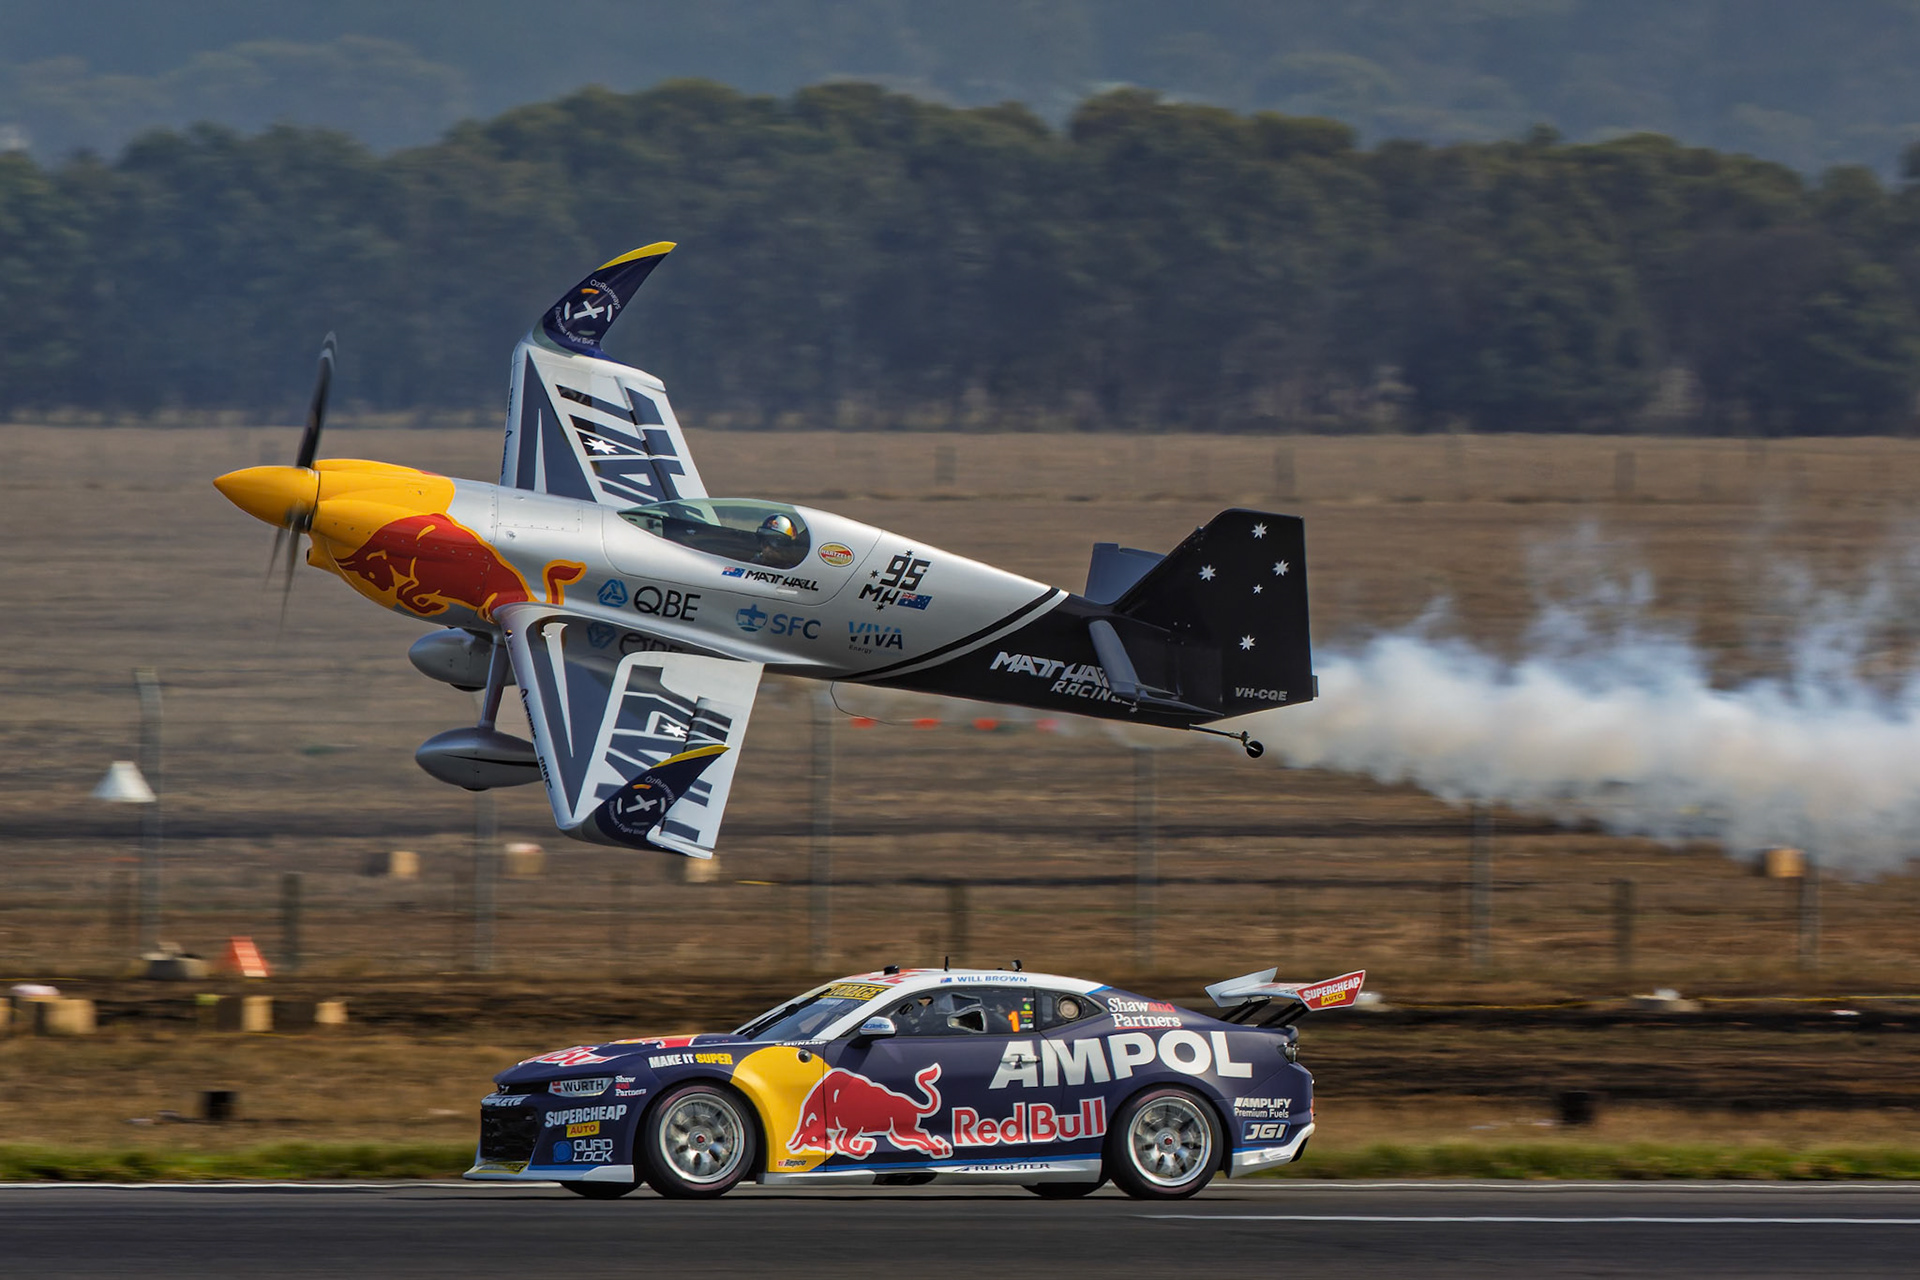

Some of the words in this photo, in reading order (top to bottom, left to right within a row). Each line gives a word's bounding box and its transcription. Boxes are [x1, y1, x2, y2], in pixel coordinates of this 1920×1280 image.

[590, 279, 621, 310] OzRunways
[744, 570, 784, 585] MATT
[782, 576, 819, 591] HALL
[879, 555, 931, 591] 95
[858, 583, 901, 605] MH
[633, 585, 702, 622] QBE
[770, 613, 821, 640] SFC
[848, 621, 903, 650] VIVA
[989, 651, 1065, 678] MATT
[1235, 687, 1288, 701] VH-CQE
[1302, 976, 1361, 1002] SUPERCHEAP
[1107, 998, 1149, 1013] Shaw
[1323, 993, 1343, 1004] AUTO
[1008, 1010, 1020, 1033] 1
[1111, 1013, 1182, 1028] Partners
[648, 1055, 684, 1069] MAKE
[682, 1053, 695, 1064] IT
[695, 1053, 733, 1065] SUPER
[988, 1030, 1253, 1090] AMPOL
[562, 1080, 604, 1092] WÜRTH
[615, 1075, 636, 1083] Shaw
[615, 1088, 647, 1097] Partners
[1241, 1097, 1292, 1109] AMPLIFY
[544, 1104, 628, 1128] SUPERCHEAP
[952, 1102, 1028, 1147] Red
[1028, 1096, 1107, 1143] Bull
[1234, 1108, 1268, 1118] Premium
[1269, 1109, 1290, 1119] Fuels
[569, 1124, 597, 1135] AUTO
[1244, 1123, 1287, 1140] JGI
[573, 1139, 613, 1152] QUAD
[572, 1149, 614, 1163] LOCK
